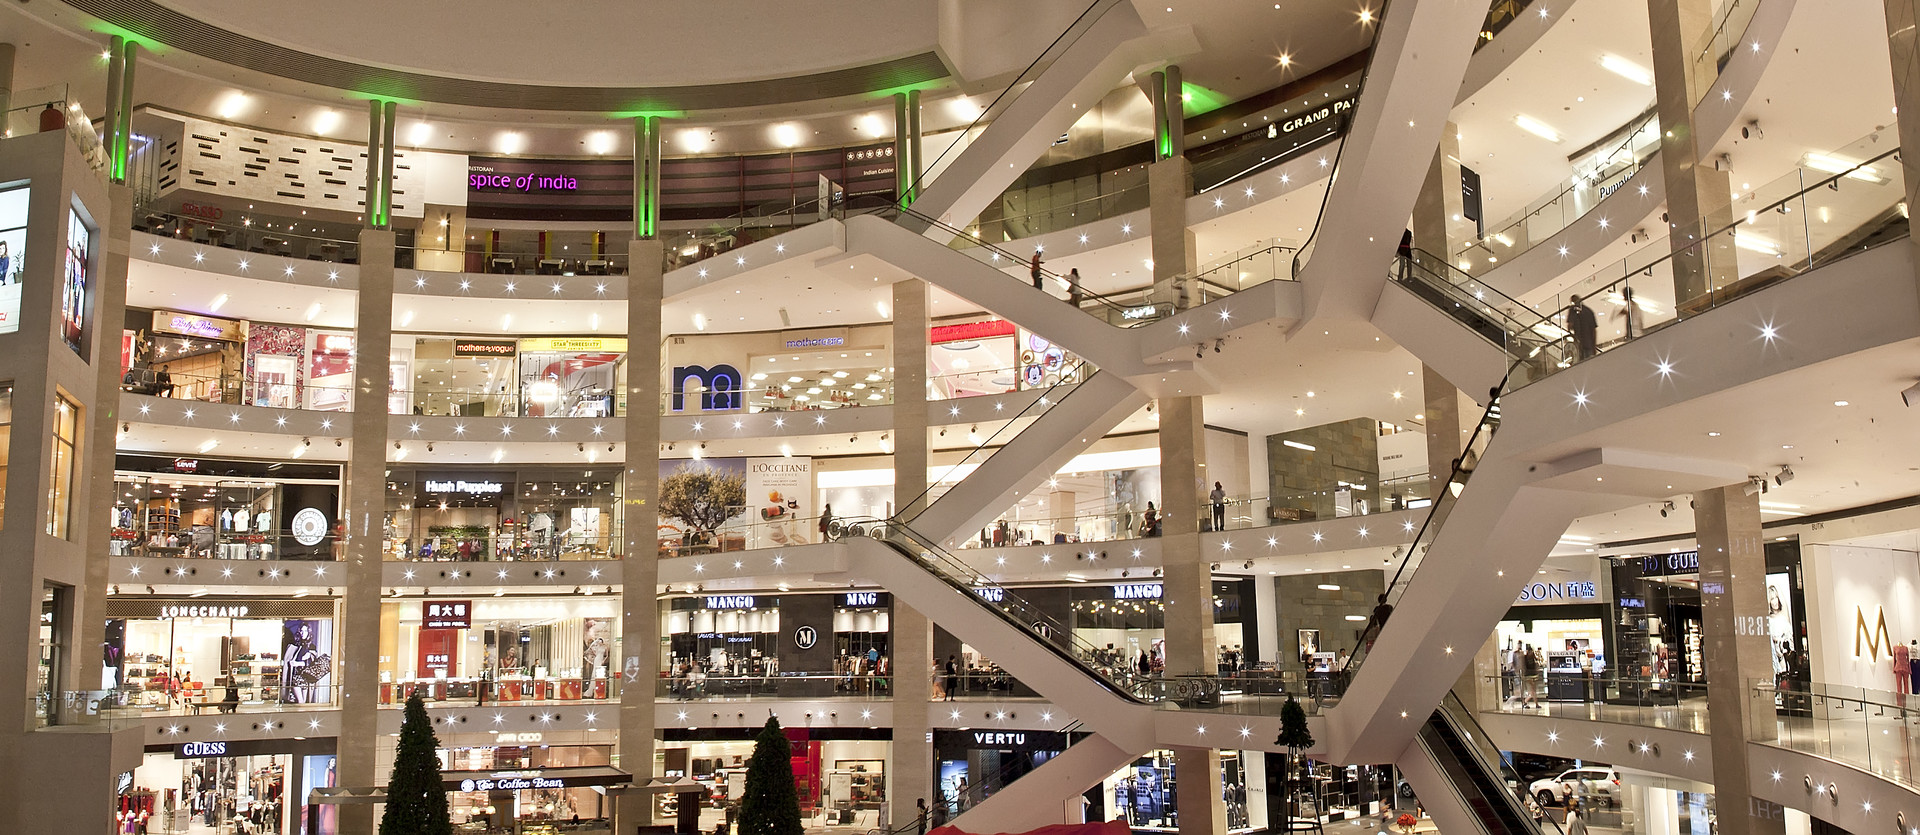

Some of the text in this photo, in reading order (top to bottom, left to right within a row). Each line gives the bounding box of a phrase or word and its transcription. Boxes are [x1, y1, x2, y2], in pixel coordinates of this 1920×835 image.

[1283, 108, 1330, 133] GRAND
[469, 173, 578, 192] spice of india
[786, 337, 844, 348] mothercare
[425, 479, 503, 494] Hush Puppies
[1113, 584, 1163, 599] MANGO
[1566, 581, 1595, 598] 百盛
[707, 596, 754, 609] MANGO
[846, 592, 877, 606] MNG
[161, 606, 249, 618] LONGCHAMP
[1855, 605, 1893, 663] M
[974, 732, 1025, 745] VERTU
[183, 742, 226, 756] GUESS
[476, 778, 563, 790] The Coffee Bean
